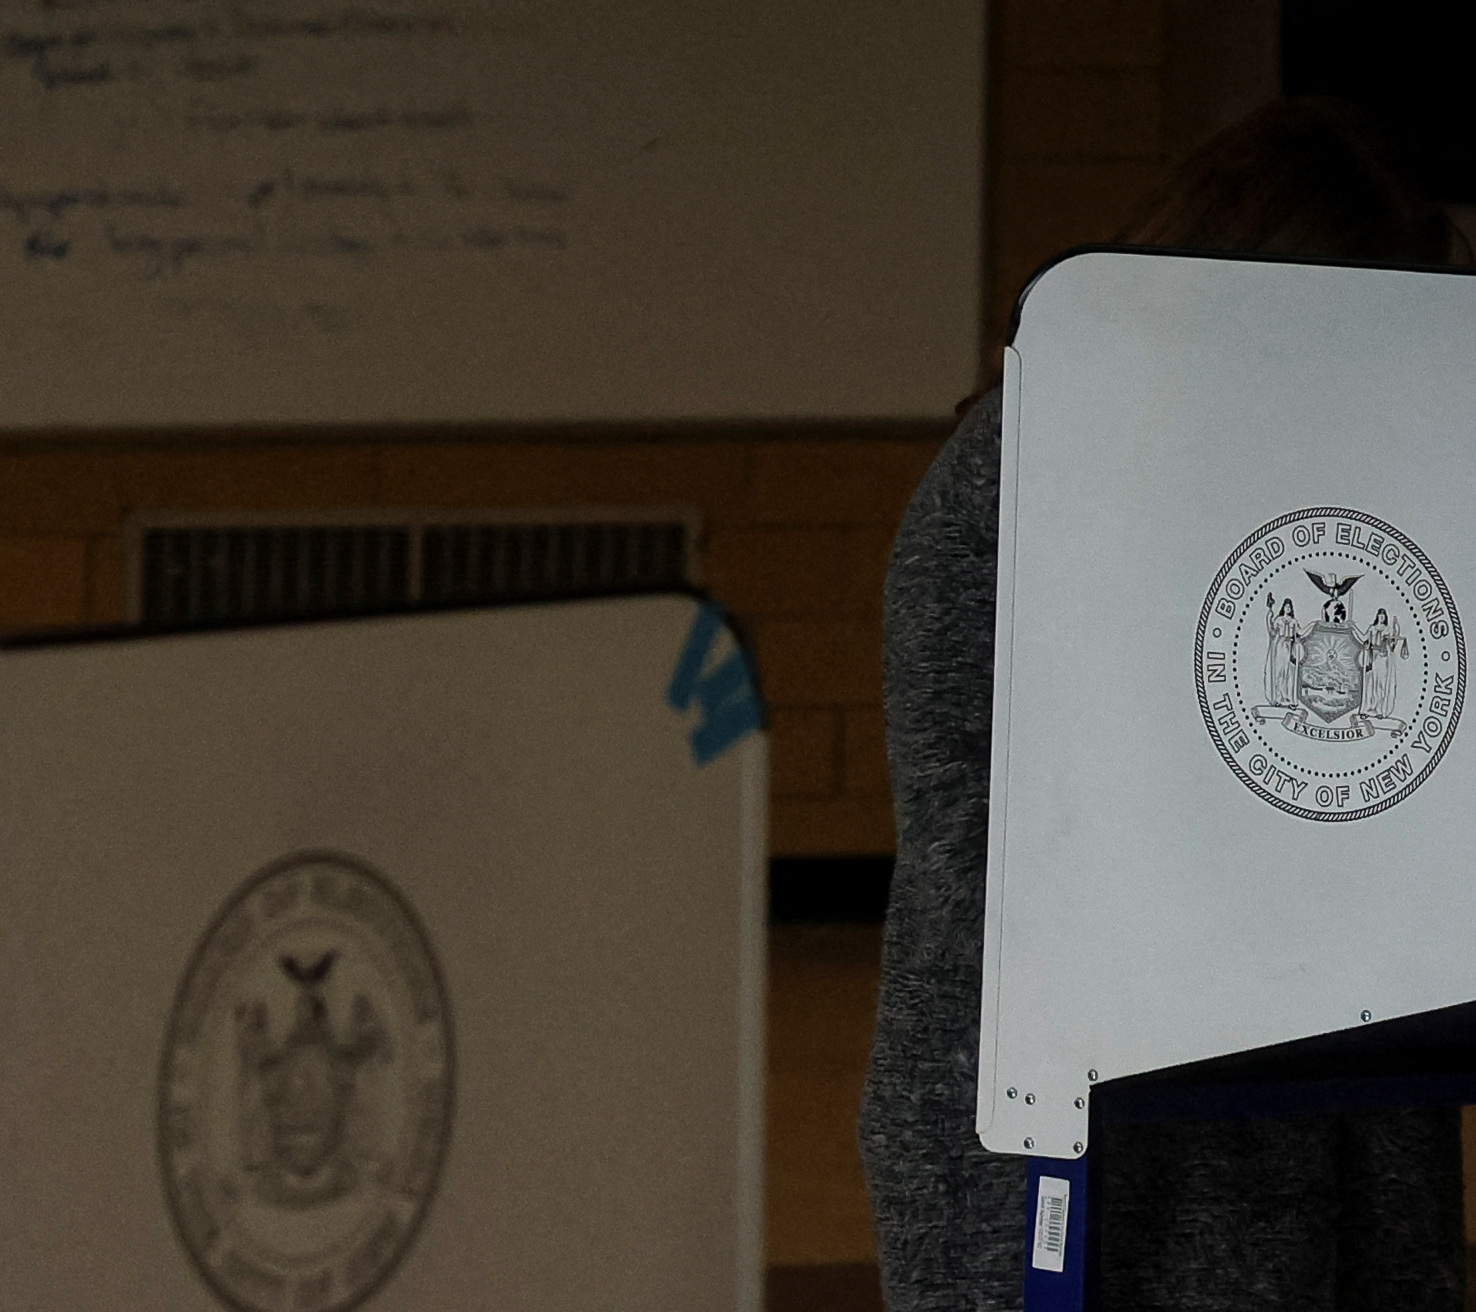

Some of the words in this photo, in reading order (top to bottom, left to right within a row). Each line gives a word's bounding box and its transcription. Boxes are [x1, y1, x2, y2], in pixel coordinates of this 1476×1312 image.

[1218, 535, 1285, 620] BOARD
[1291, 522, 1326, 548] OF
[1336, 522, 1449, 640] ELECTIONS
[1207, 651, 1227, 684] IN
[1213, 693, 1250, 753] THE
[1293, 722, 1364, 739] EXCELSIOR
[1412, 673, 1454, 752] YORK
[1249, 753, 1308, 801] CITY
[1315, 785, 1351, 808] OF
[1359, 754, 1414, 802] NEW
